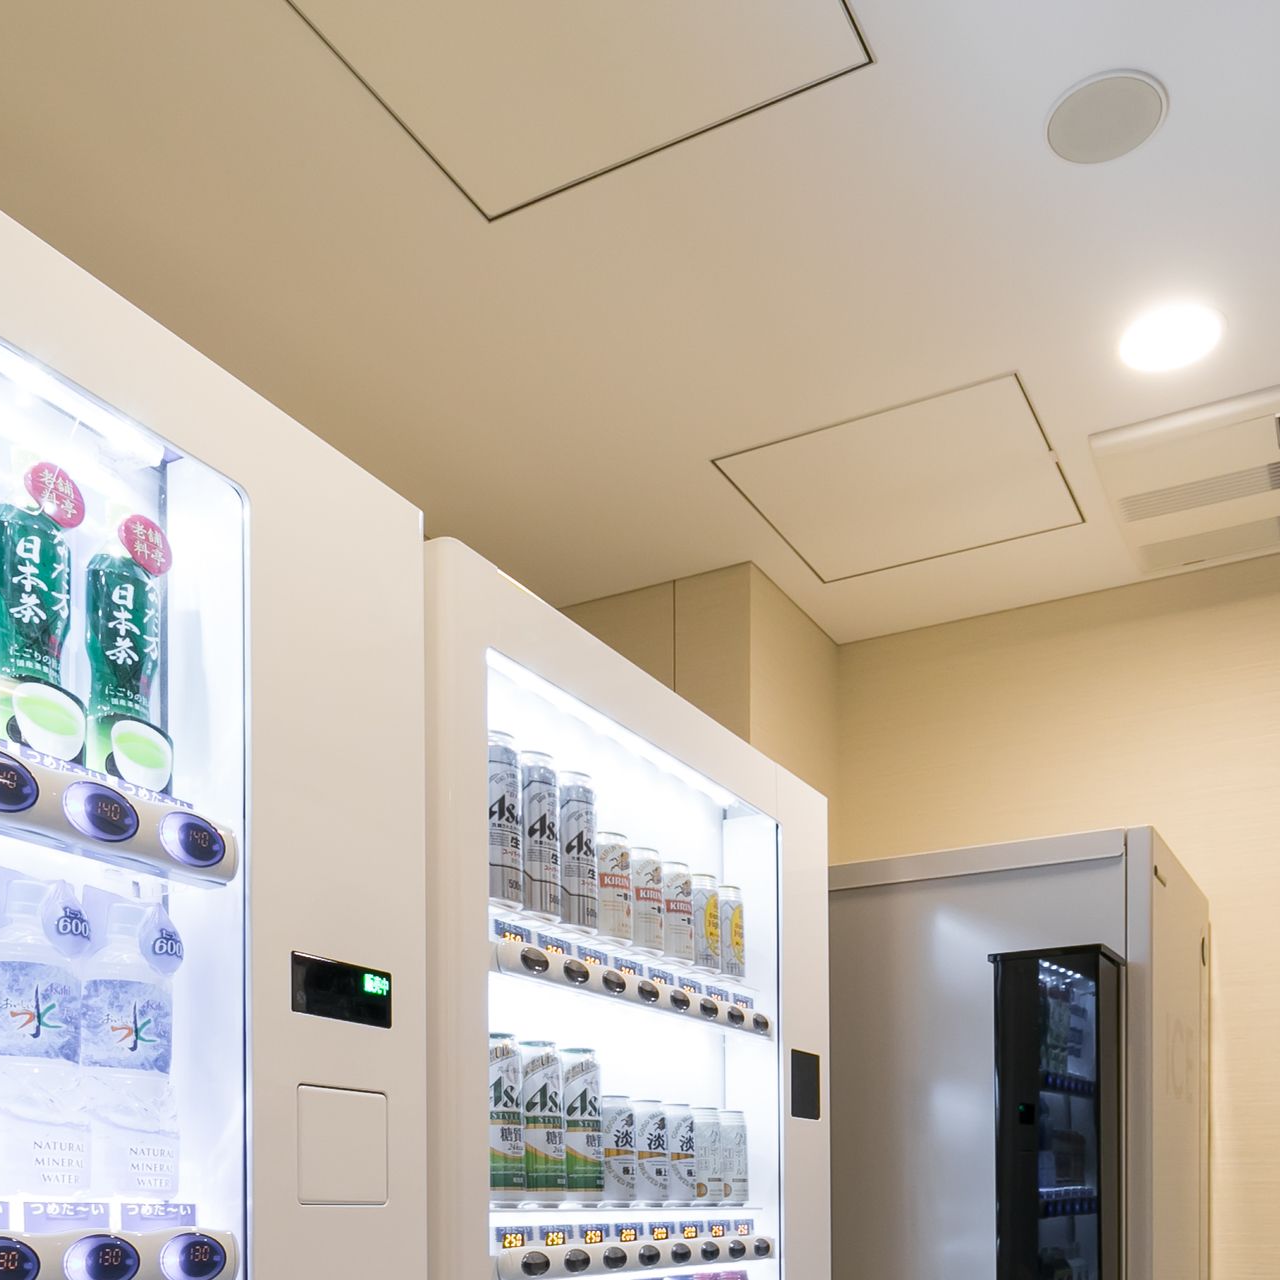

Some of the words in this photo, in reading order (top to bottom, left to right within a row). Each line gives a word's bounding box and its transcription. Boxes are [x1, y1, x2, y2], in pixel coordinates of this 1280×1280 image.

[9, 536, 48, 624] 日本茶
[106, 583, 140, 665] 日本茶
[33, 1140, 86, 1153] NATURAL
[613, 1129, 634, 1149] 淡
[647, 1132, 666, 1151] 淡
[34, 1157, 84, 1170] MINERAL
[41, 1173, 81, 1185] WATER
